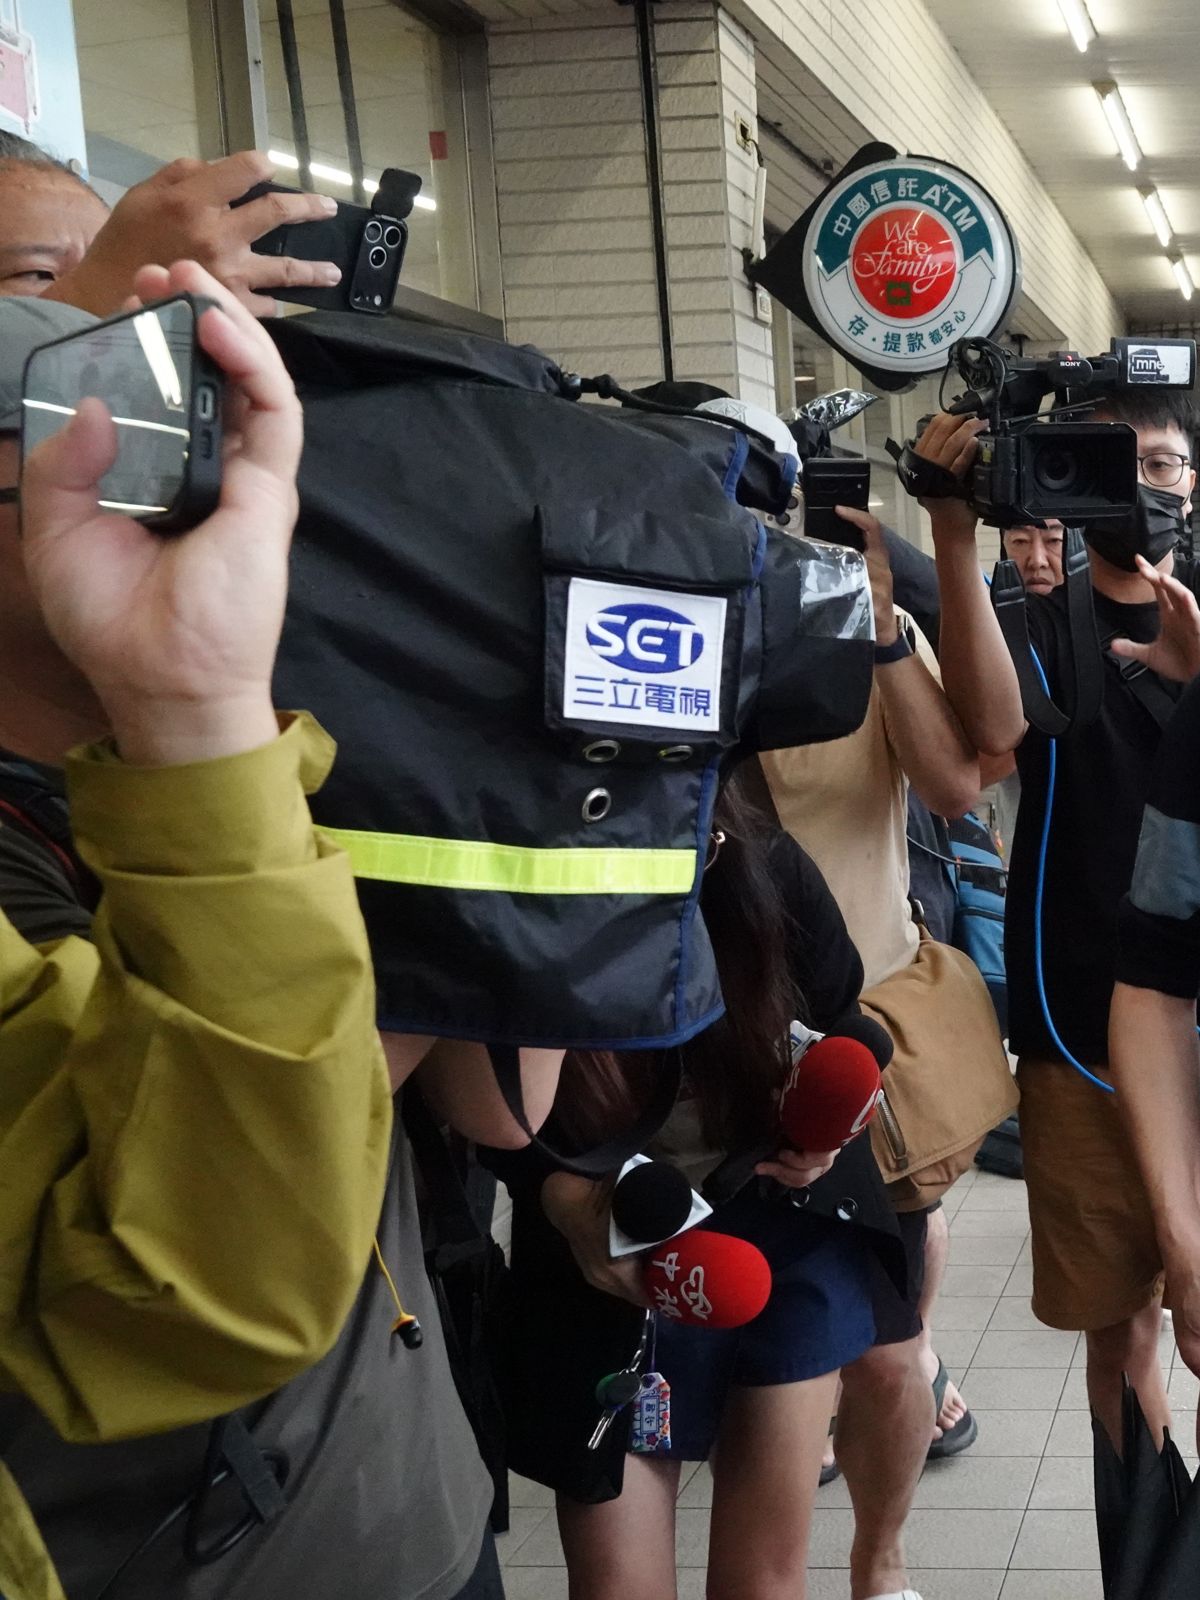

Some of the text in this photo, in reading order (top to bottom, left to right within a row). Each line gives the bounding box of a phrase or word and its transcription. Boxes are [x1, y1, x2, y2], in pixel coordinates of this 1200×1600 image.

[884, 221, 918, 241] We
[586, 612, 702, 667] SET
[573, 675, 711, 717] 三立電視
